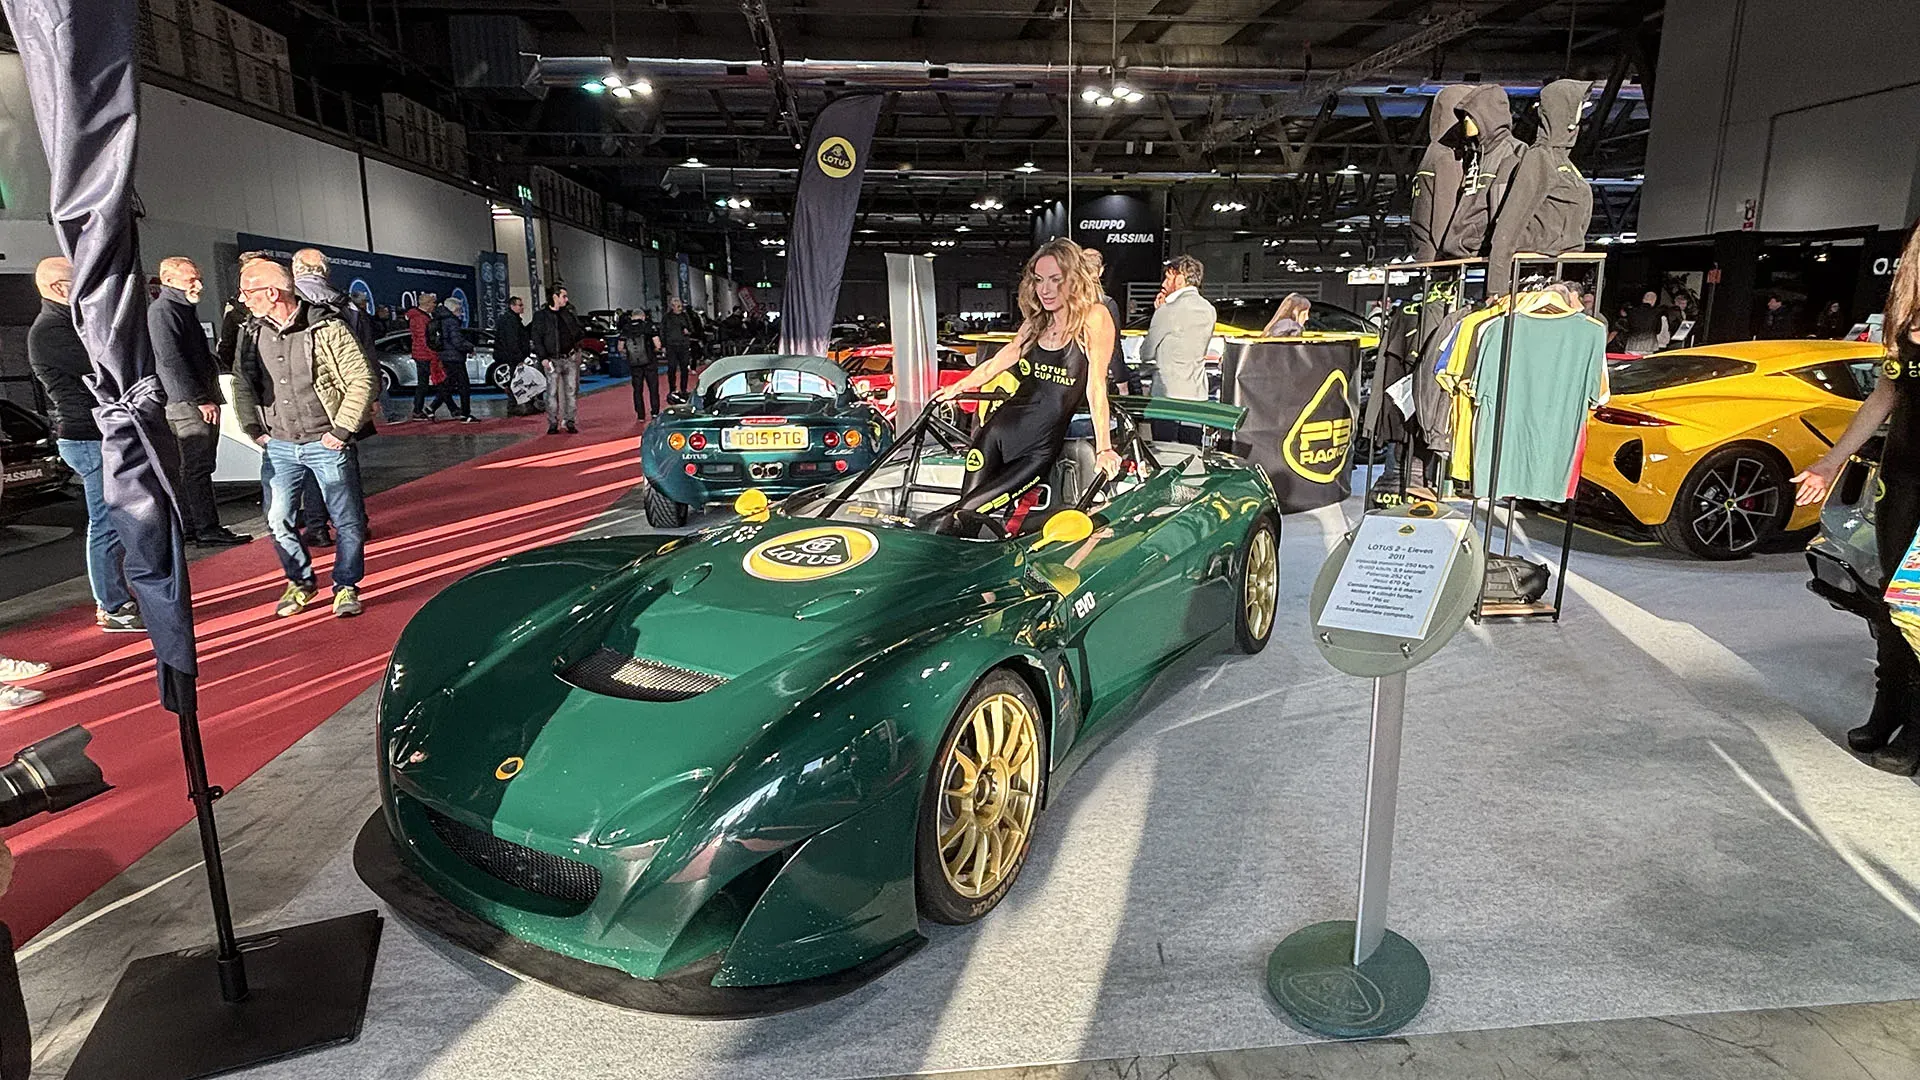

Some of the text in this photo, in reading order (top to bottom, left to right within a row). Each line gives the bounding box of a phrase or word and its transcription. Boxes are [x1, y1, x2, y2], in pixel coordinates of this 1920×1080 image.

[822, 154, 850, 168] LOTUS
[1079, 219, 1126, 230] GRUPPO
[1106, 233, 1155, 243] FASSINA
[1034, 362, 1067, 377] LOTUS
[1034, 370, 1077, 386] CUP ITALY
[772, 432, 802, 445] PTG
[976, 492, 1011, 514] PB
[845, 505, 878, 518] PB
[766, 545, 842, 565] LOTUS
[1367, 543, 1394, 552] LOTUS
[1407, 546, 1434, 554] Eleven
[1074, 591, 1096, 619] evo
